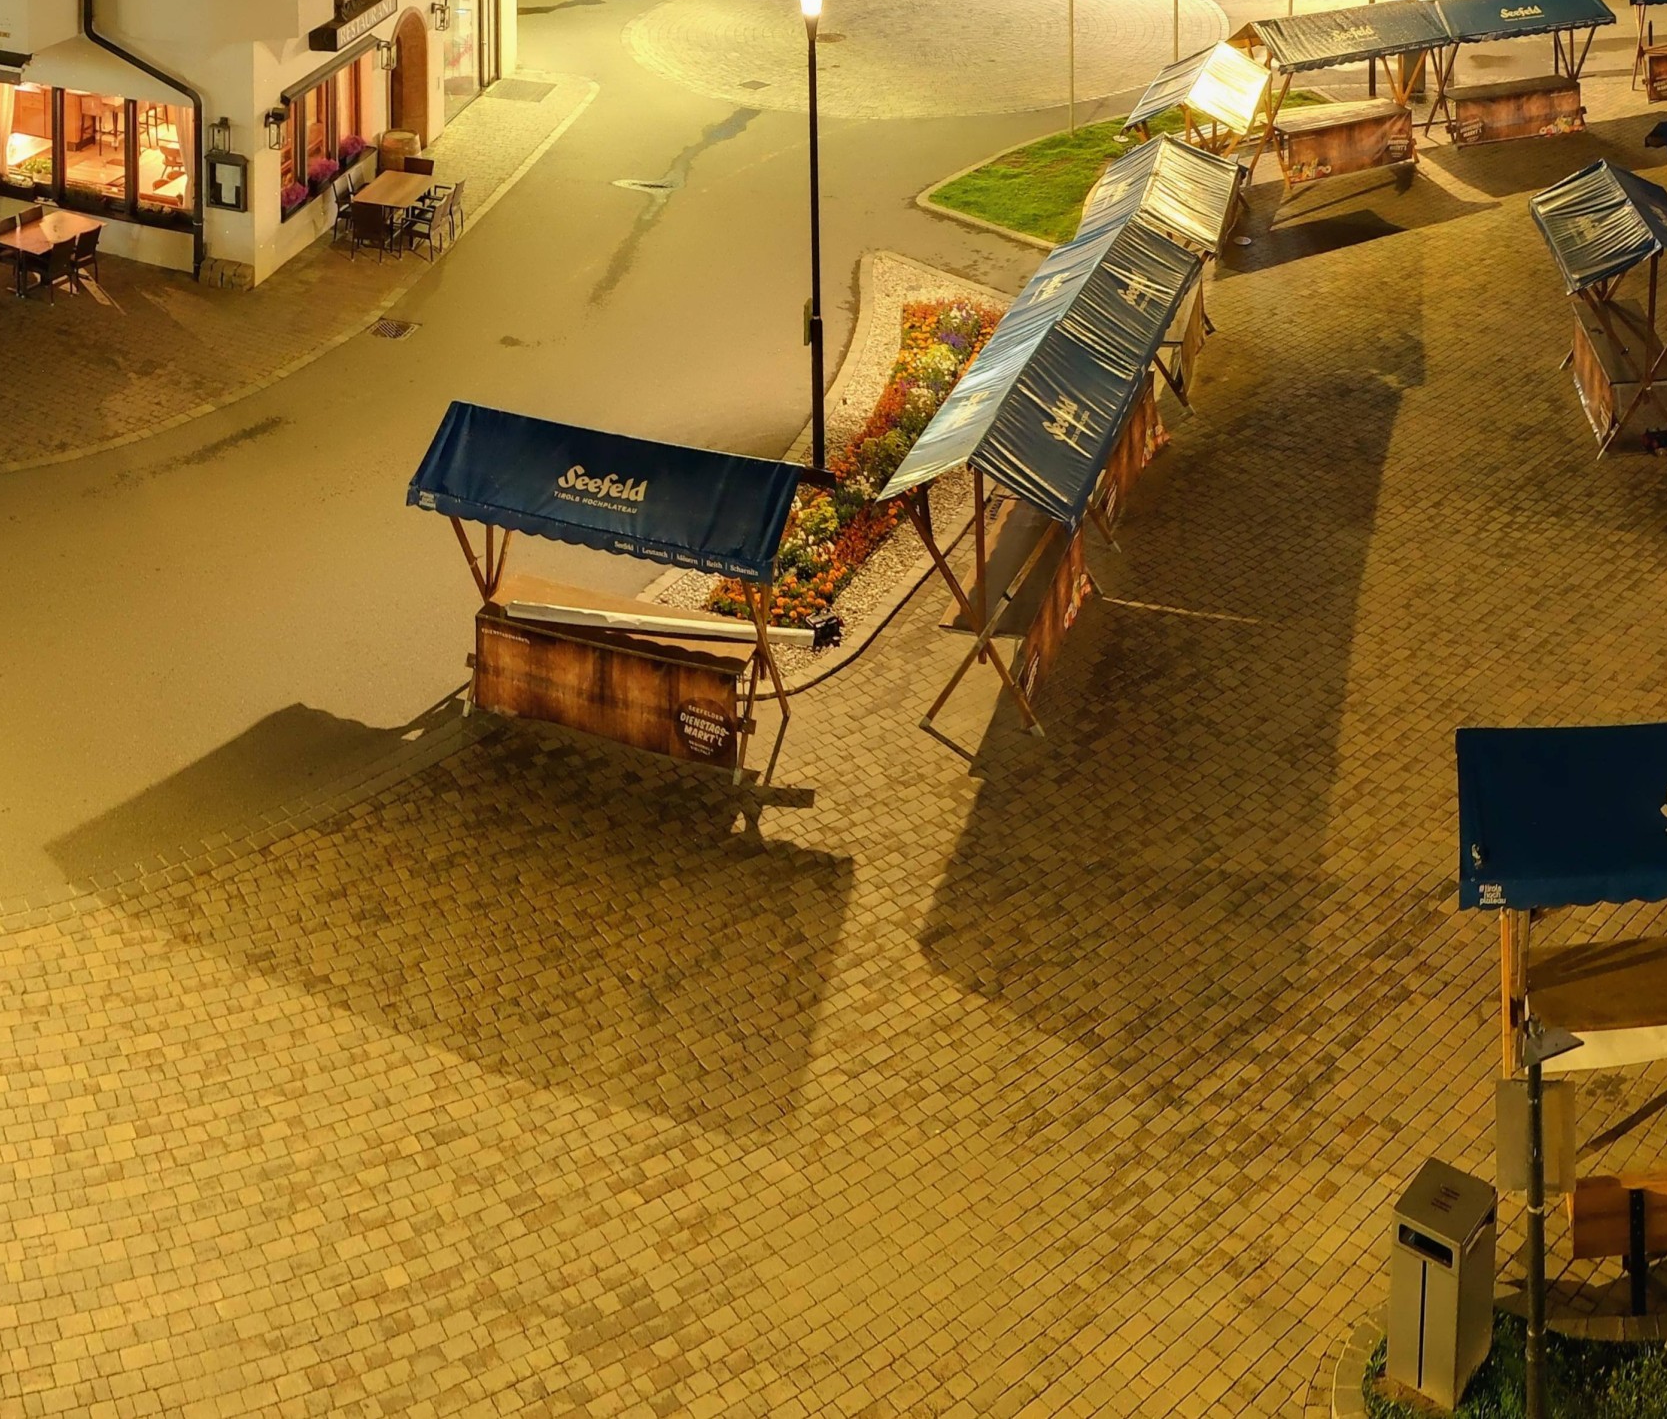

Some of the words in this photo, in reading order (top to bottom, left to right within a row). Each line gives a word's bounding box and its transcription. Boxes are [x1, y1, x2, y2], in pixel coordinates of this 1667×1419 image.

[1500, 5, 1542, 19] Seefeld
[557, 464, 648, 502] Seefeld
[553, 490, 580, 505] TIROLS
[581, 495, 638, 514] HOCHPLATEAU
